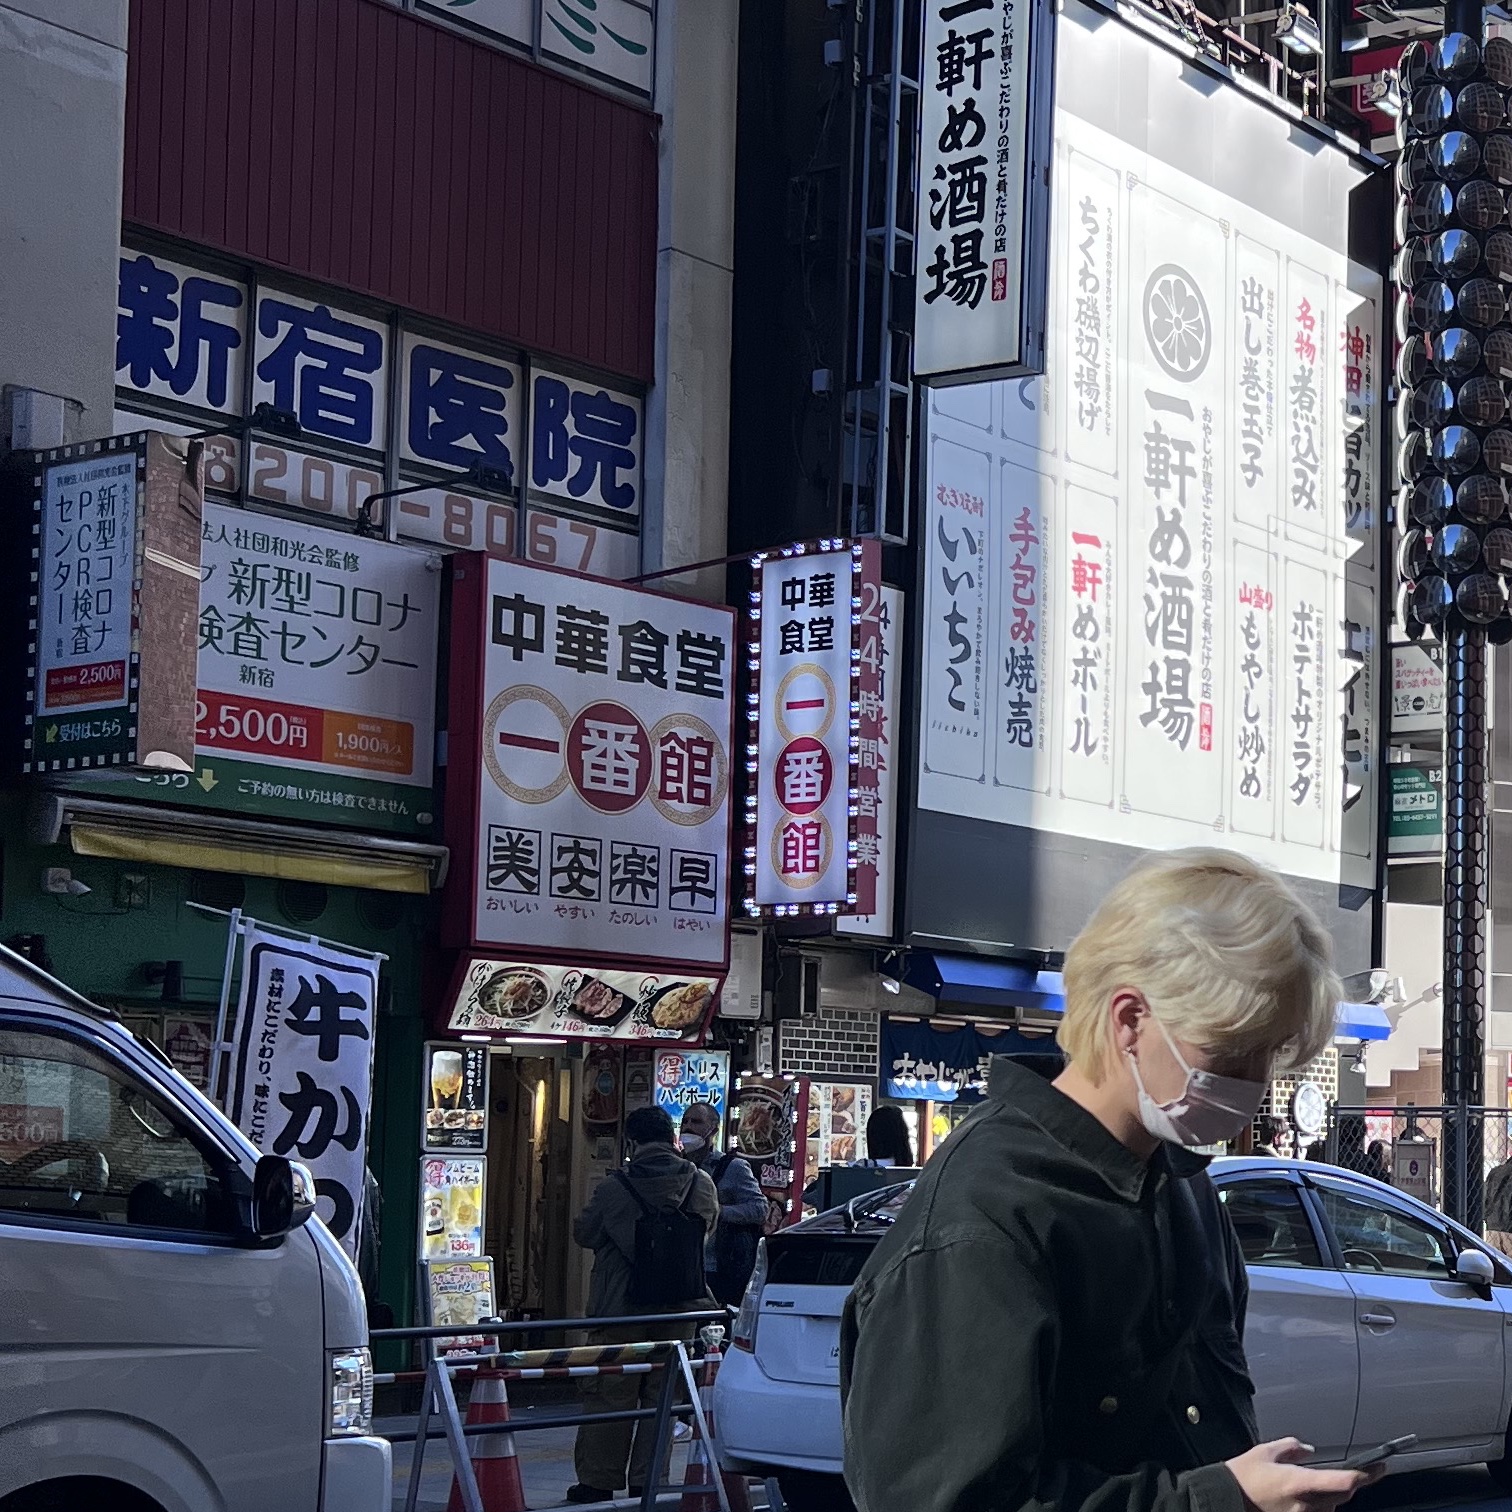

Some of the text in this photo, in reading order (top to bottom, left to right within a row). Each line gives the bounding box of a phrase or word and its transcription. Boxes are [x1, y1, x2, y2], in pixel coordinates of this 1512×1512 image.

[924, 0, 996, 310] 一軒め酒場
[993, 0, 1014, 253] やじが喜ぶこだわりの酒と肴だけの店
[116, 254, 637, 509] 新宿医院
[1074, 195, 1102, 432] ちくわ磯辺揚げ
[1239, 276, 1265, 488] 出し巻玉子
[1289, 297, 1319, 512] 名物煮込み
[53, 494, 73, 624] センター
[71, 490, 93, 655] PCR検査
[93, 483, 118, 652] 新型コロナ
[227, 558, 422, 632] 新型コロナ
[780, 617, 834, 655] 食堂
[781, 573, 835, 611] 中華
[938, 515, 977, 712] いいちこ
[1004, 507, 1039, 748] 手包み焼売
[1139, 388, 1197, 751] 一軒め酒場
[1238, 581, 1273, 612] 山盛り
[239, 664, 275, 688] 新宿
[492, 593, 726, 699] 中華食堂
[857, 581, 880, 866] 24時間営業
[1069, 531, 1102, 757] 一軒めボール
[1239, 611, 1265, 798] もやし炒め
[1290, 600, 1314, 806] ポテトサラダ
[59, 718, 122, 743] 受付はこちら
[499, 717, 715, 808] 一番館
[783, 699, 824, 875] 一番館
[485, 896, 711, 933] おいしい やすい たのしい はやい
[493, 830, 713, 905] 美 安 楽 早
[659, 1055, 720, 1085] 得 トリス
[660, 1088, 721, 1106] ハイボール
